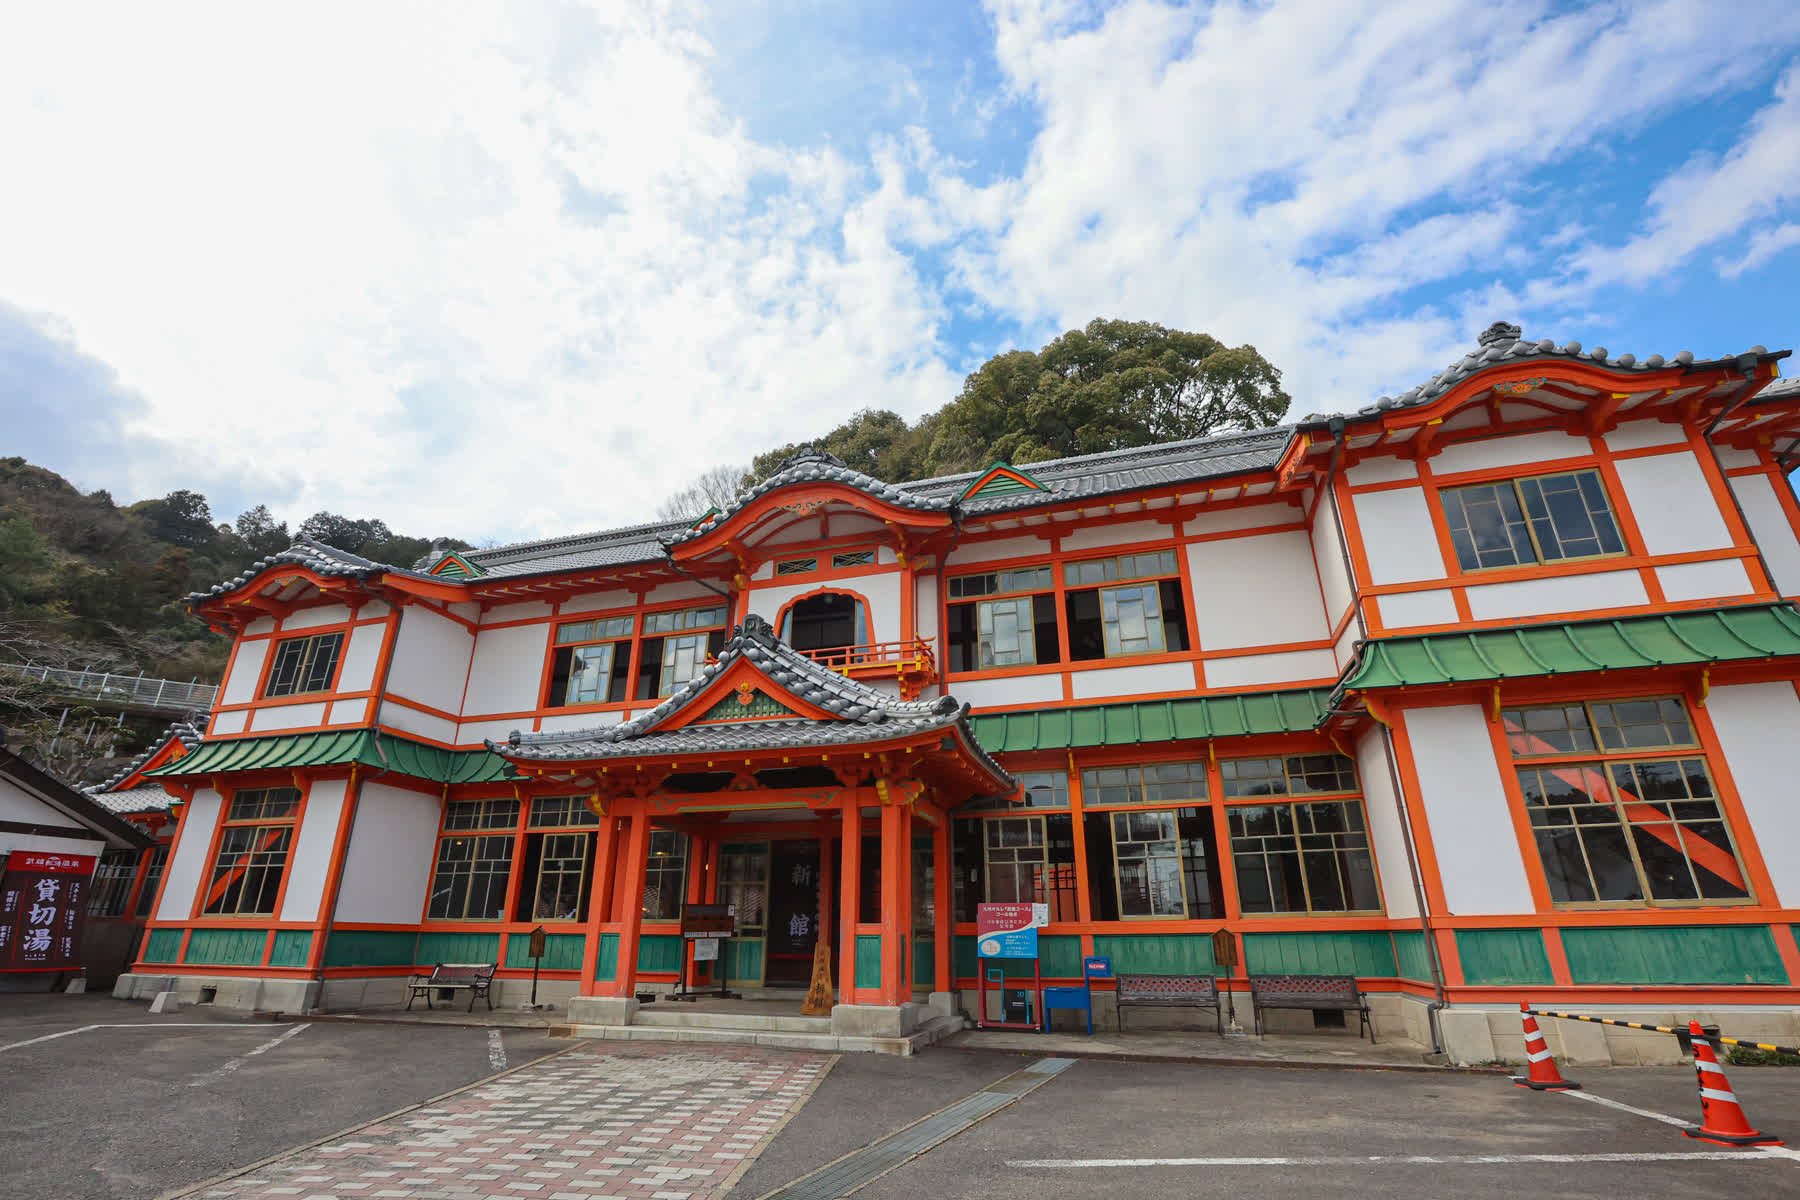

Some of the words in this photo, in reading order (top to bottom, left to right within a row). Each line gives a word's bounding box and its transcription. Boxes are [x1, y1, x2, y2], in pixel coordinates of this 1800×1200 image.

[23, 879, 60, 951] 貸切湯
[789, 864, 811, 937] 新館
